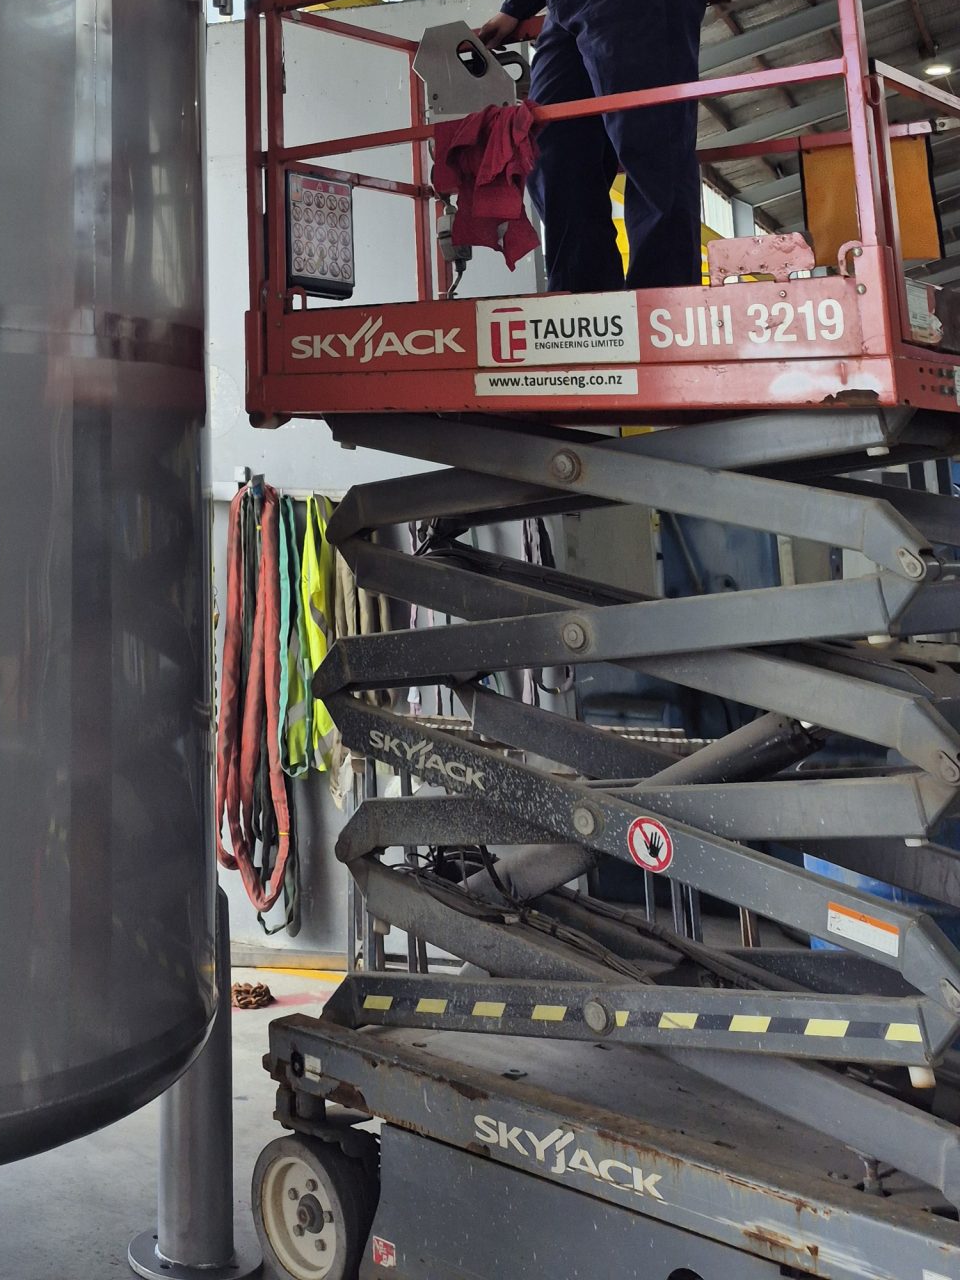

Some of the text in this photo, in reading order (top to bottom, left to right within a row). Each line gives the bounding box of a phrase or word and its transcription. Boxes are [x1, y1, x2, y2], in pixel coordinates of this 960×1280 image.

[291, 316, 467, 363] SKYJACK
[530, 314, 623, 340] TAURUS
[534, 338, 625, 350] ENGINEERING LIMITED
[650, 299, 845, 349] SJIII 3219
[489, 373, 623, 390] www.tauruseng.co.nz
[369, 729, 486, 791] SKYJACK
[474, 1114, 664, 1200] SKYJACK
